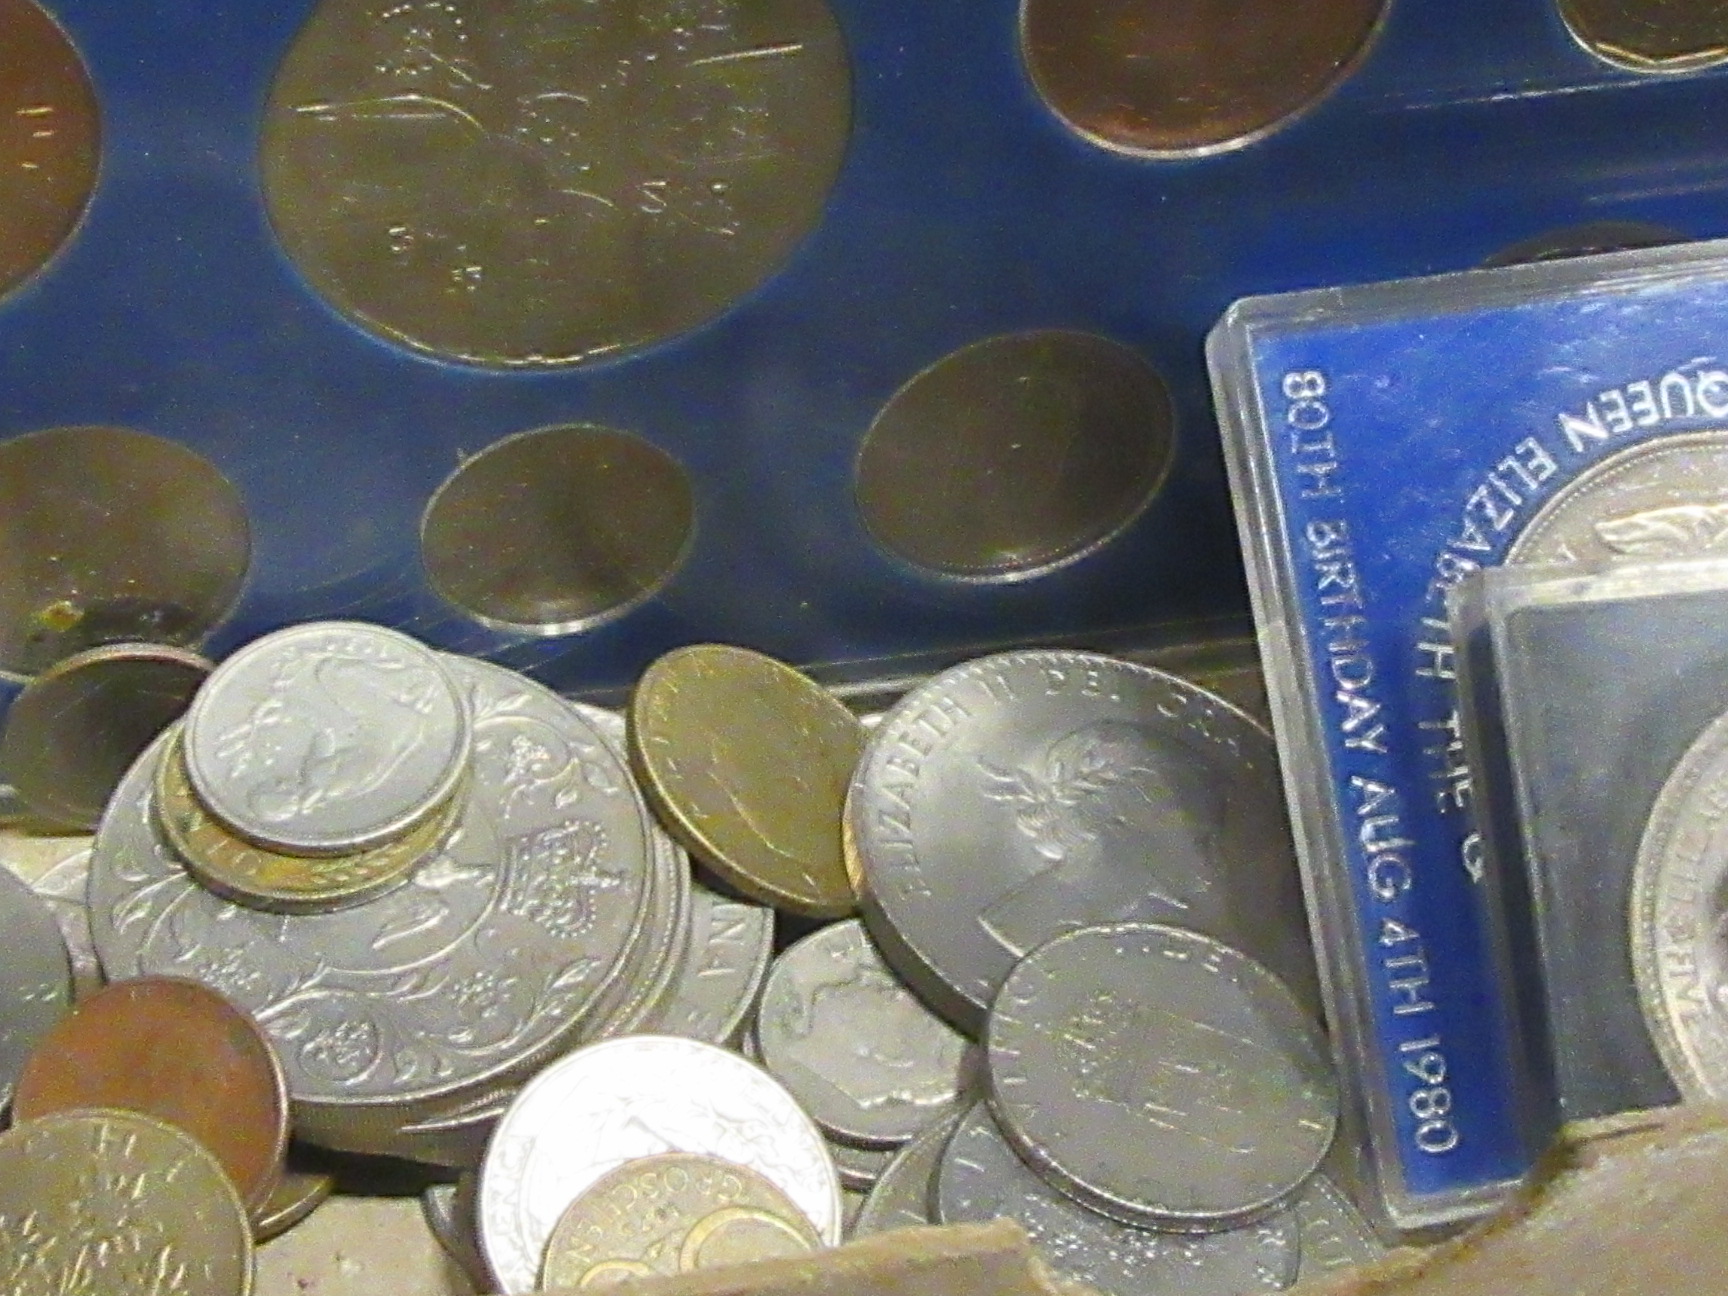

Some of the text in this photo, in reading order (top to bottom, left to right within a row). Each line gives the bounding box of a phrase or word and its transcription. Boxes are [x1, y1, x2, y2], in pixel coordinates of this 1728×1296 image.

[1281, 368, 1461, 1155] 80TH BIRTHDAY AUG 4TH 1980
